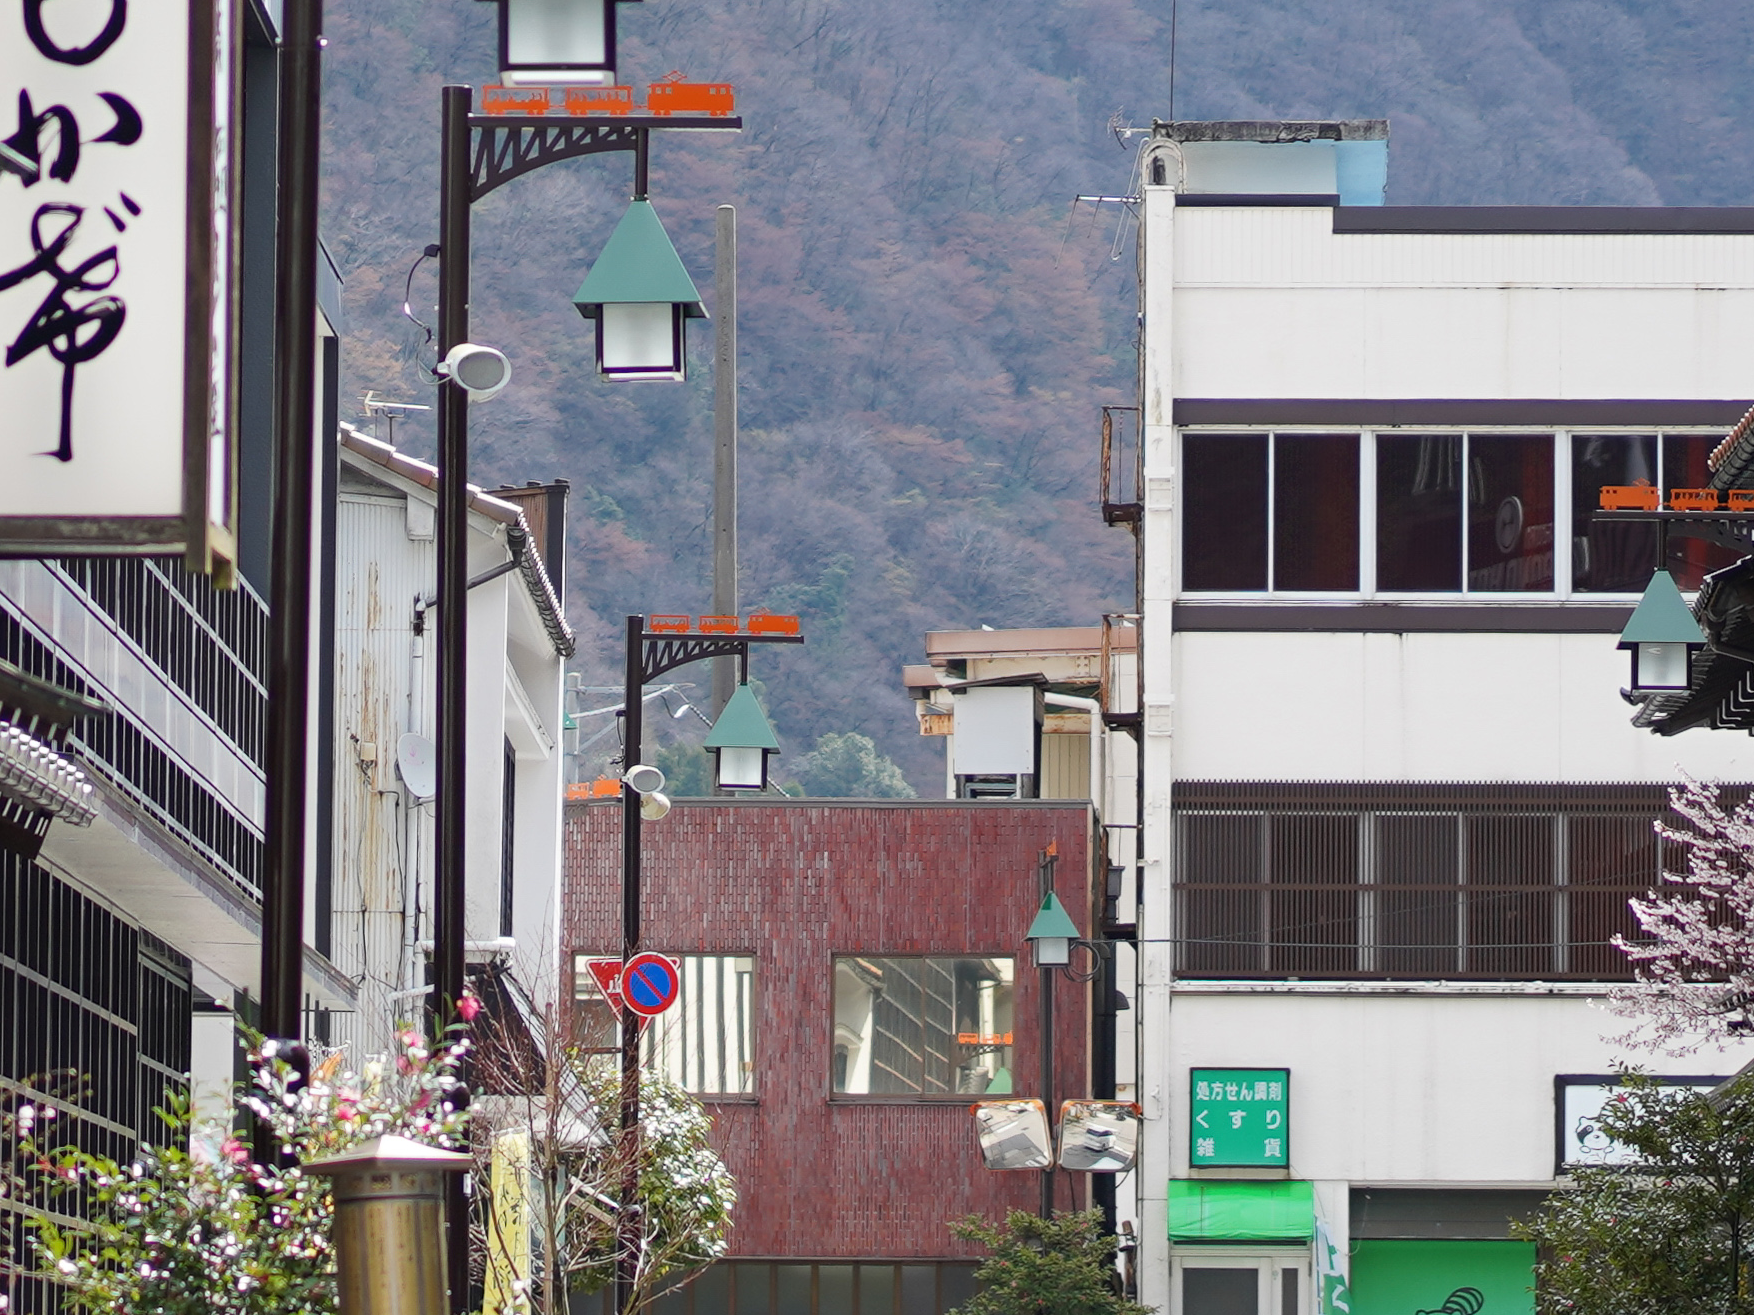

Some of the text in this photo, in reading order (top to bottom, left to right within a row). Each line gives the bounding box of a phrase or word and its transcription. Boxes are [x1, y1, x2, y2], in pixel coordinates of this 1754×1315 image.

[1195, 1080, 1283, 1102] 処方せん調剤
[1195, 1109, 1282, 1130] くすり
[1195, 1137, 1282, 1158] 雑貨
